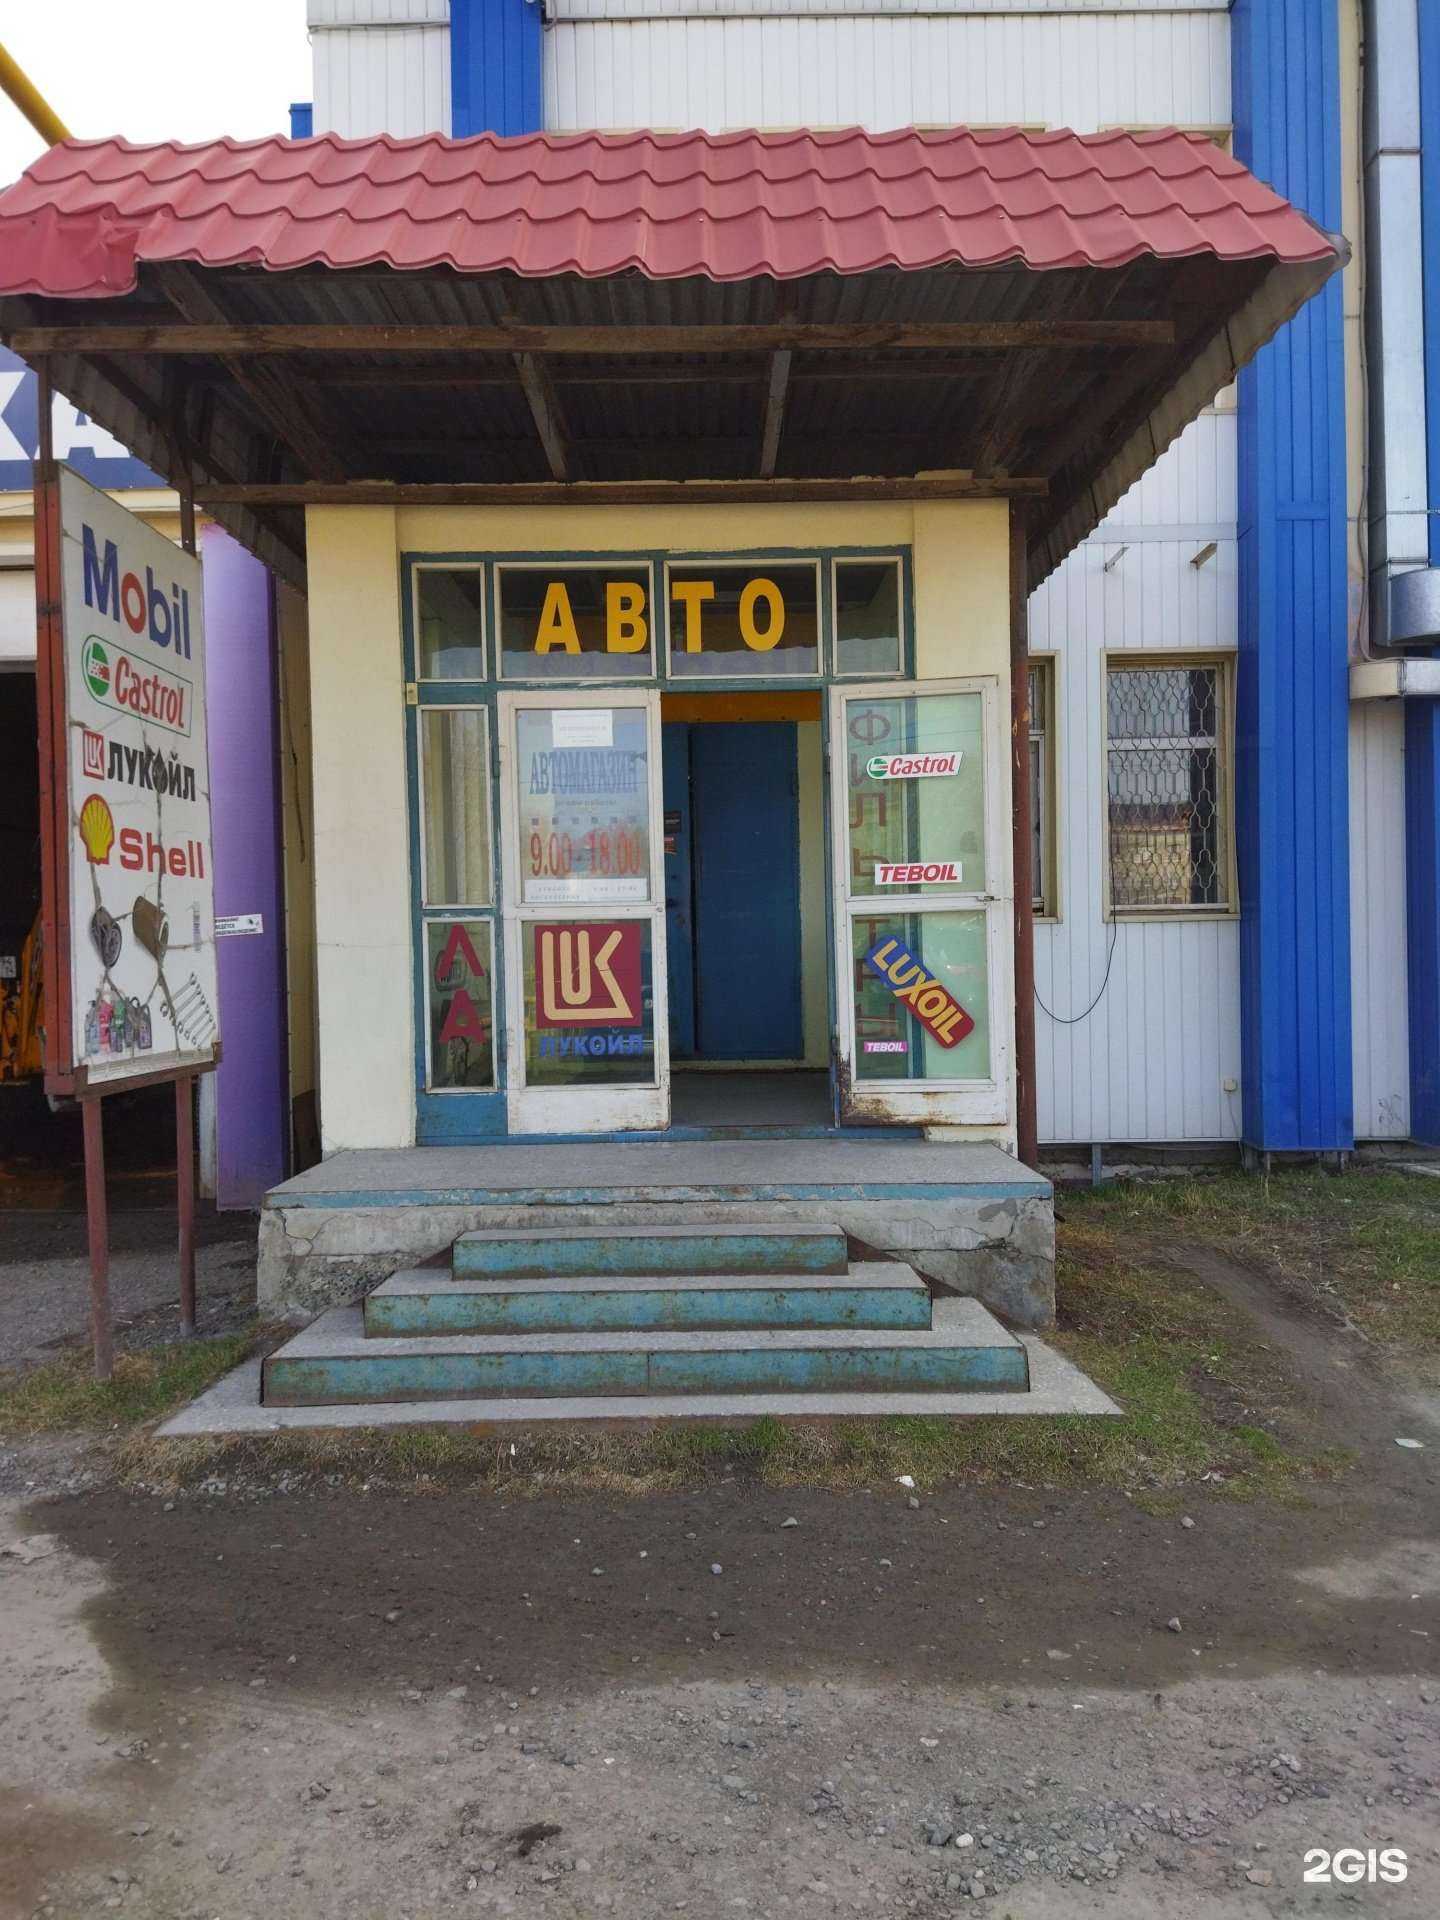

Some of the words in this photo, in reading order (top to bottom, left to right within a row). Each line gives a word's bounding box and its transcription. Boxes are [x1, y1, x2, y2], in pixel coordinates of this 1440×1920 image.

[82, 523, 191, 660] Mobil
[534, 578, 785, 655] АВТО
[115, 656, 185, 729] Castrol
[889, 755, 956, 777] Castrol
[120, 827, 204, 879] Shell
[880, 863, 958, 883] TEBOIL
[872, 940, 964, 1044] LUXOIL
[539, 1026, 644, 1057] ЛУКОЙЛ
[866, 1042, 905, 1053] TEBOIL
